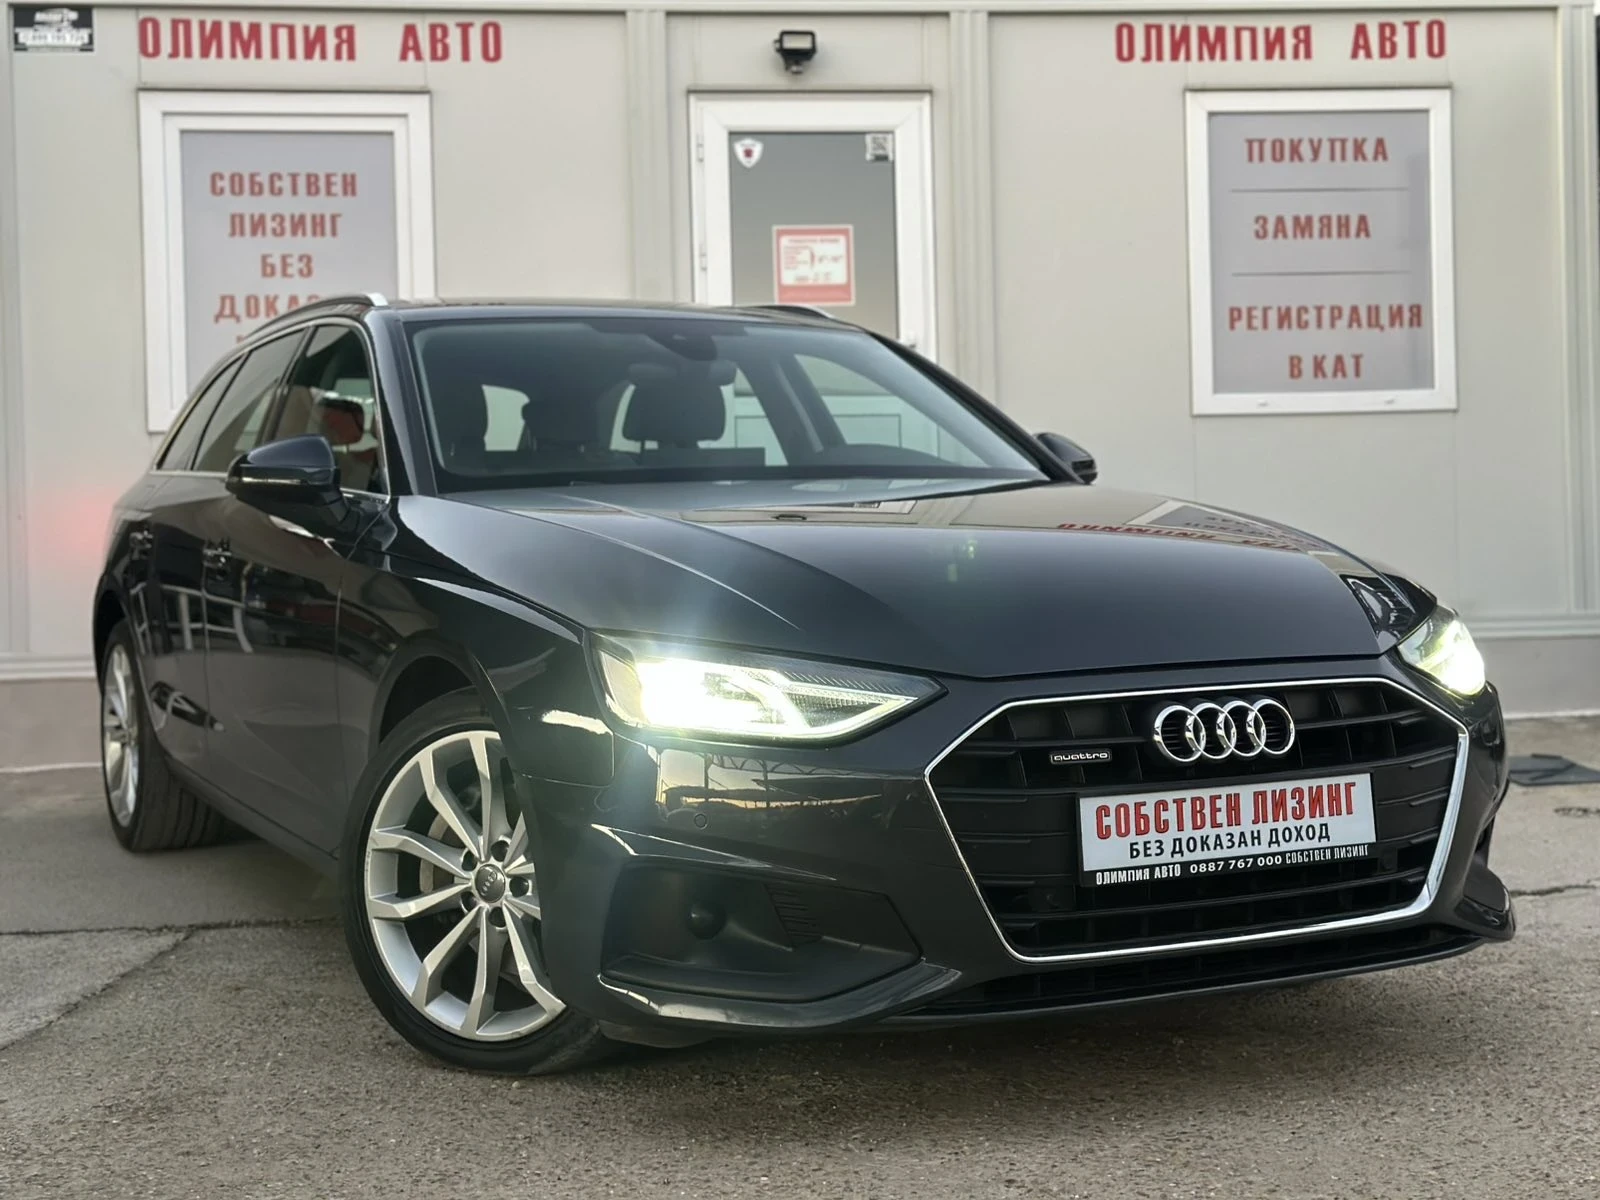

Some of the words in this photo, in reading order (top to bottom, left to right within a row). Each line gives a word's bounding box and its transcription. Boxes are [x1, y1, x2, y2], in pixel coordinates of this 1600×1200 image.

[138, 17, 357, 62] ОЛИМПИЯ
[399, 21, 503, 63] АВТО
[1114, 22, 1313, 63] ОЛИМПИЯ
[1350, 19, 1447, 60] АВТО
[1245, 137, 1389, 163] ПОКУПКА
[209, 171, 358, 198] СОБСТВЕН
[228, 213, 343, 238] ЛИЗИНГ
[1254, 214, 1371, 240] ЗАМЯНА
[260, 253, 314, 279] БЕЗ
[1228, 303, 1423, 332] РЕГИСТРАЦИЯ
[1288, 355, 1303, 380] В
[1312, 354, 1364, 380] КАТ
[1053, 751, 1109, 762] quattro
[1096, 793, 1242, 840] СОБСТВЕН
[1252, 782, 1356, 825] ЛИЗИНГ
[1129, 840, 1165, 859] БЕЗ
[1170, 832, 1262, 858] ДОКАЗАН
[1268, 823, 1331, 848] ДОХОД
[1095, 868, 1150, 885] ОЛИМПИЯ
[1154, 863, 1182, 878] АВТО
[1189, 860, 1225, 874] 0887
[1229, 857, 1253, 870] 767
[1257, 854, 1282, 867] 000
[1285, 848, 1332, 864] СОБСТВЕН
[1334, 844, 1370, 860] ЛИЗИНГ
